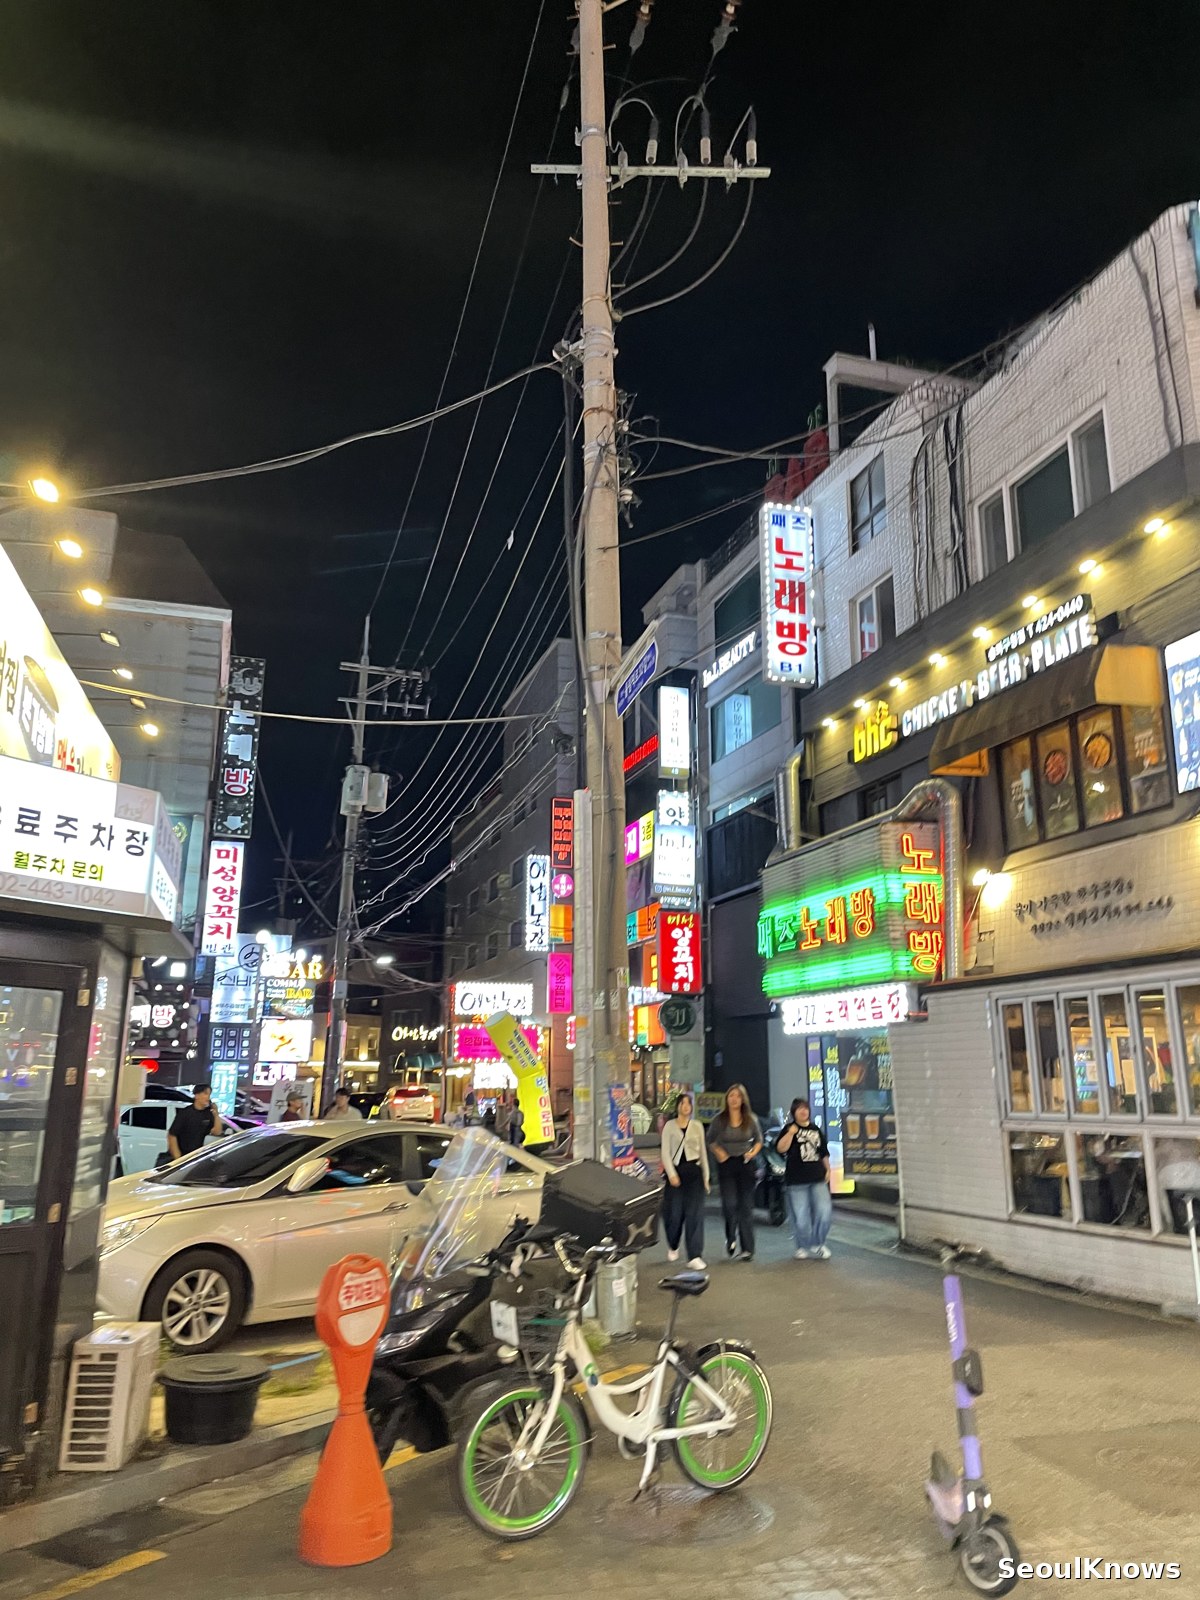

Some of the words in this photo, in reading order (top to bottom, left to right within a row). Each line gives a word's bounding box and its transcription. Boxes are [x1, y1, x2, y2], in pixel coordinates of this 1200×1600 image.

[774, 537, 810, 656] 노래방
[780, 661, 802, 673] B1
[854, 715, 895, 762] bhc
[0, 805, 149, 857] 료주차장
[14, 851, 65, 875] 월주차
[72, 861, 104, 881] 문의
[207, 846, 239, 940] 미성양꼬치
[901, 833, 942, 973] 노래방
[671, 927, 694, 982] 양꼬치
